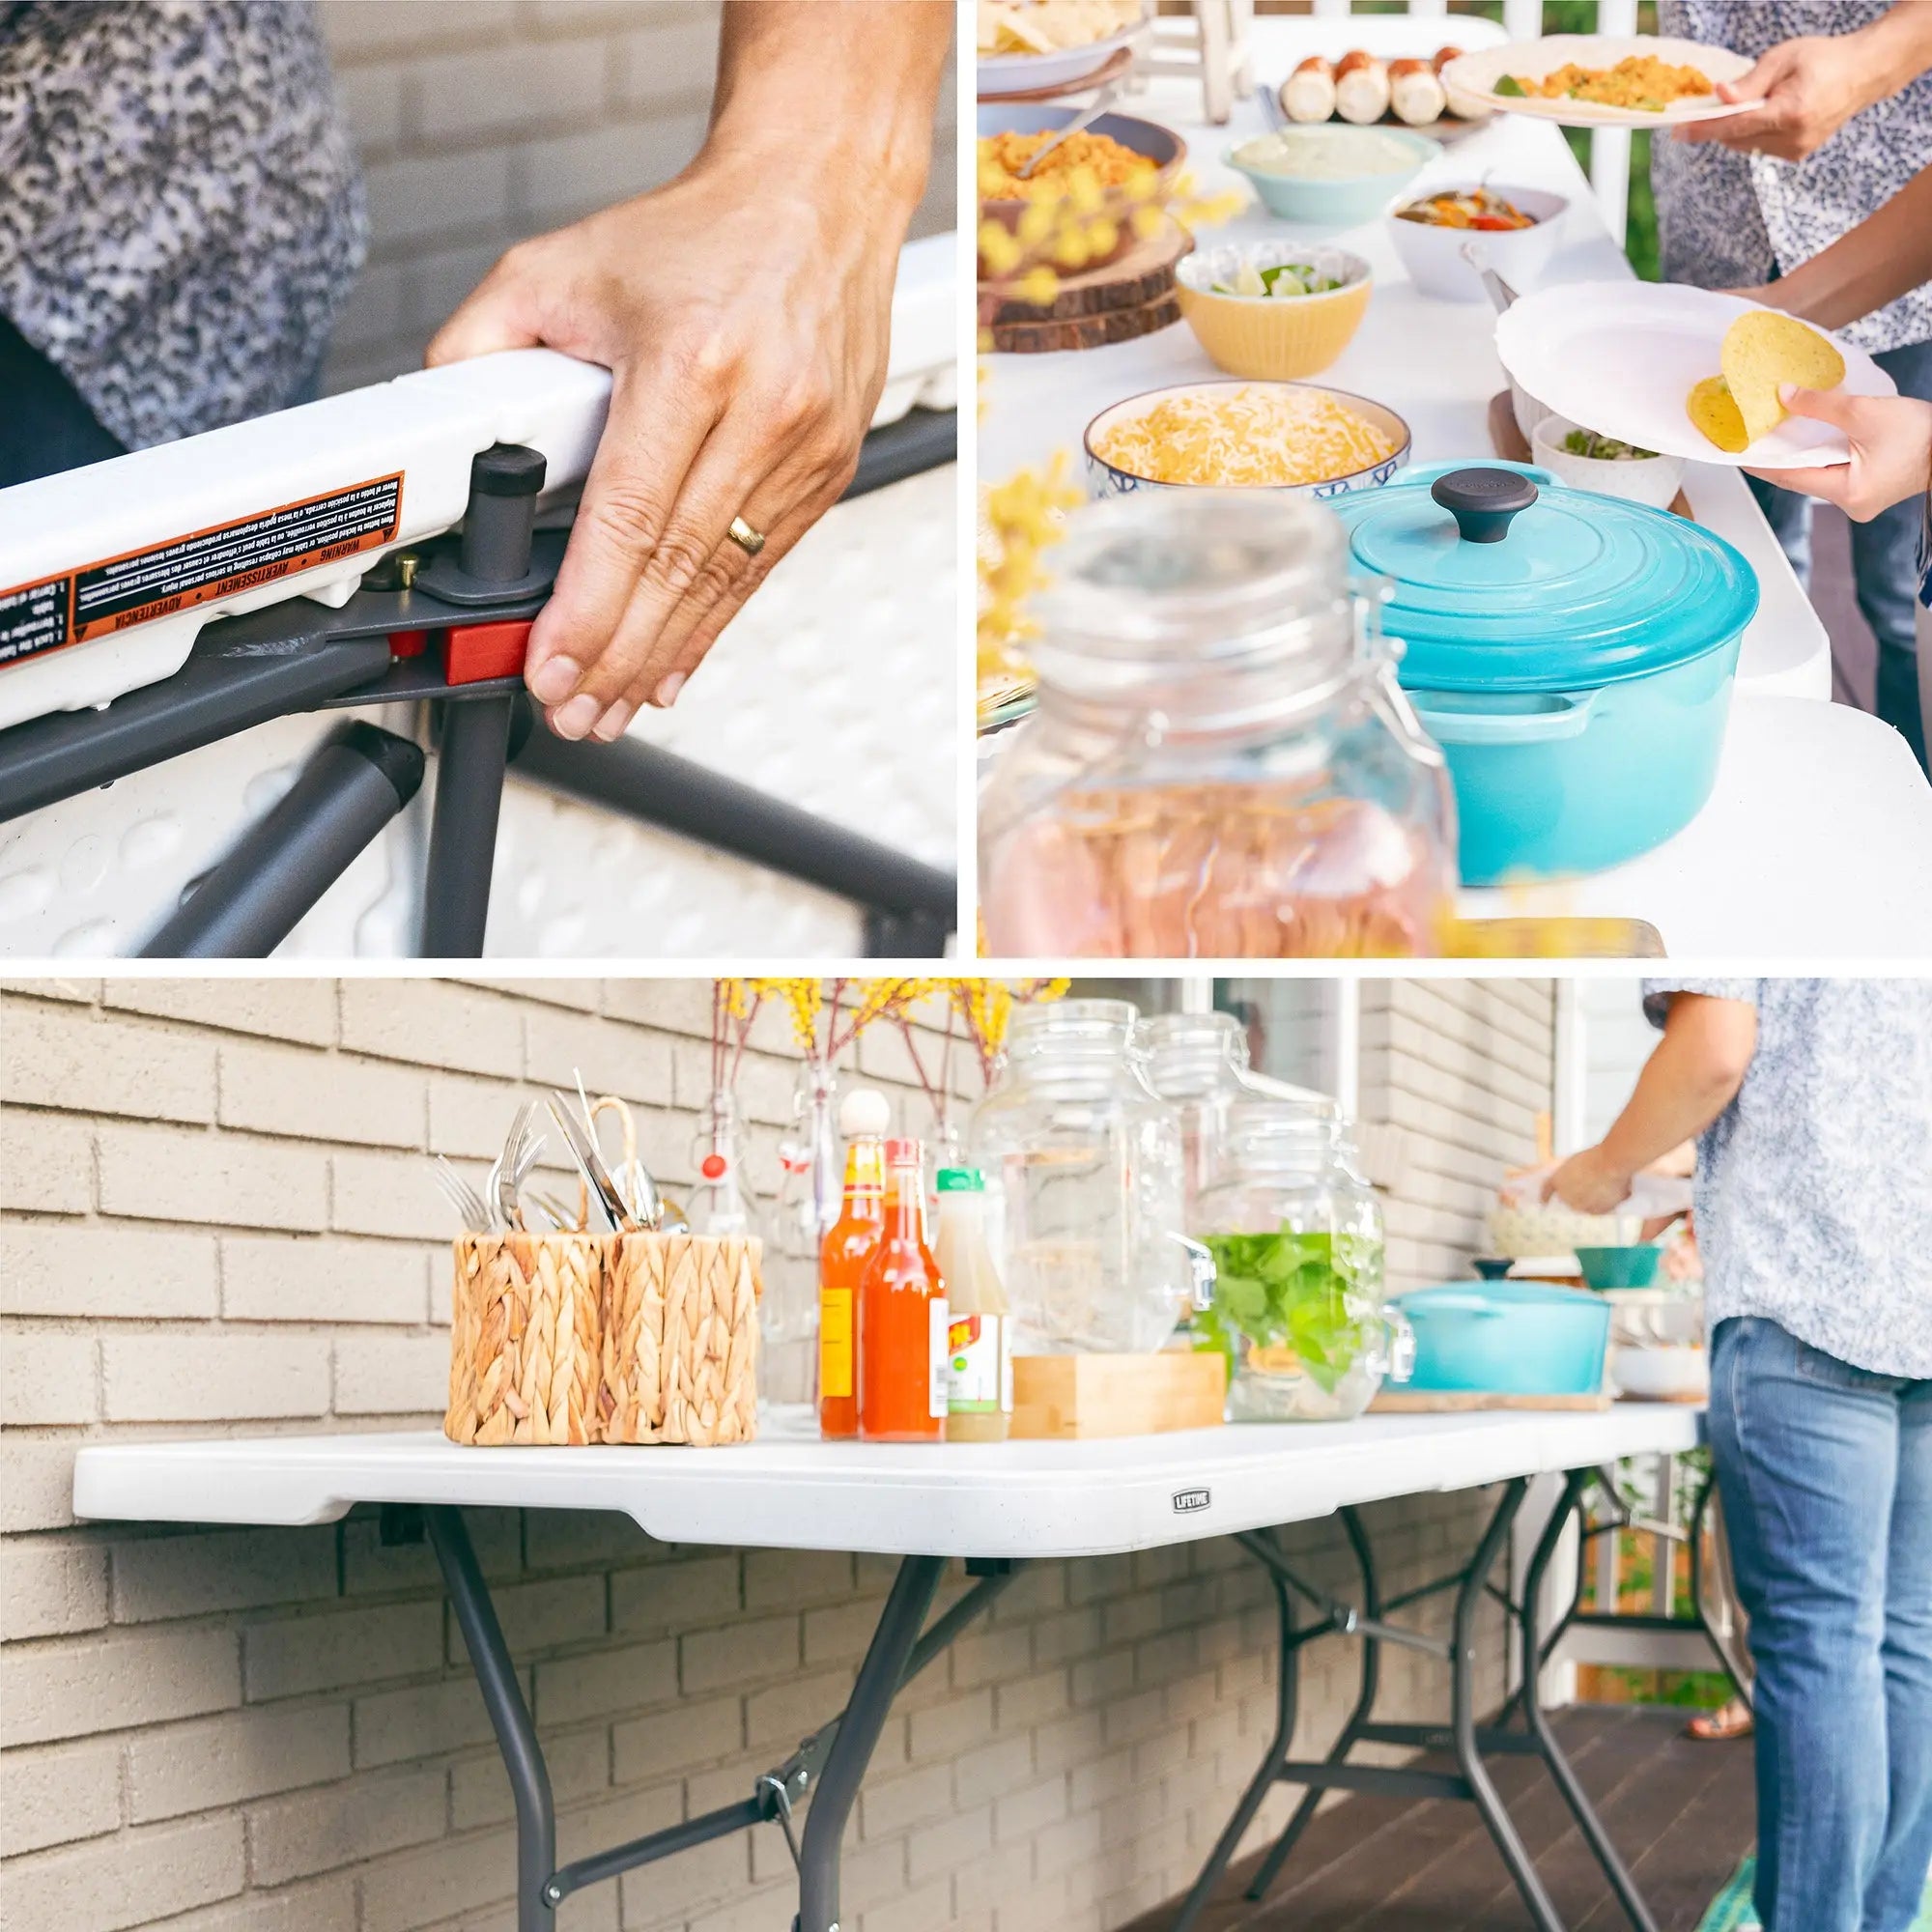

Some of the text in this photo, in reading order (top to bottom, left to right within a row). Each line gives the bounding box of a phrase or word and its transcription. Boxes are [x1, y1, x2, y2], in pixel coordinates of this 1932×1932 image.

[115, 540, 359, 630] WARNING AVERTISSEMENT ADVERTENCIA
[1176, 1491, 1208, 1509] LIFETIME
